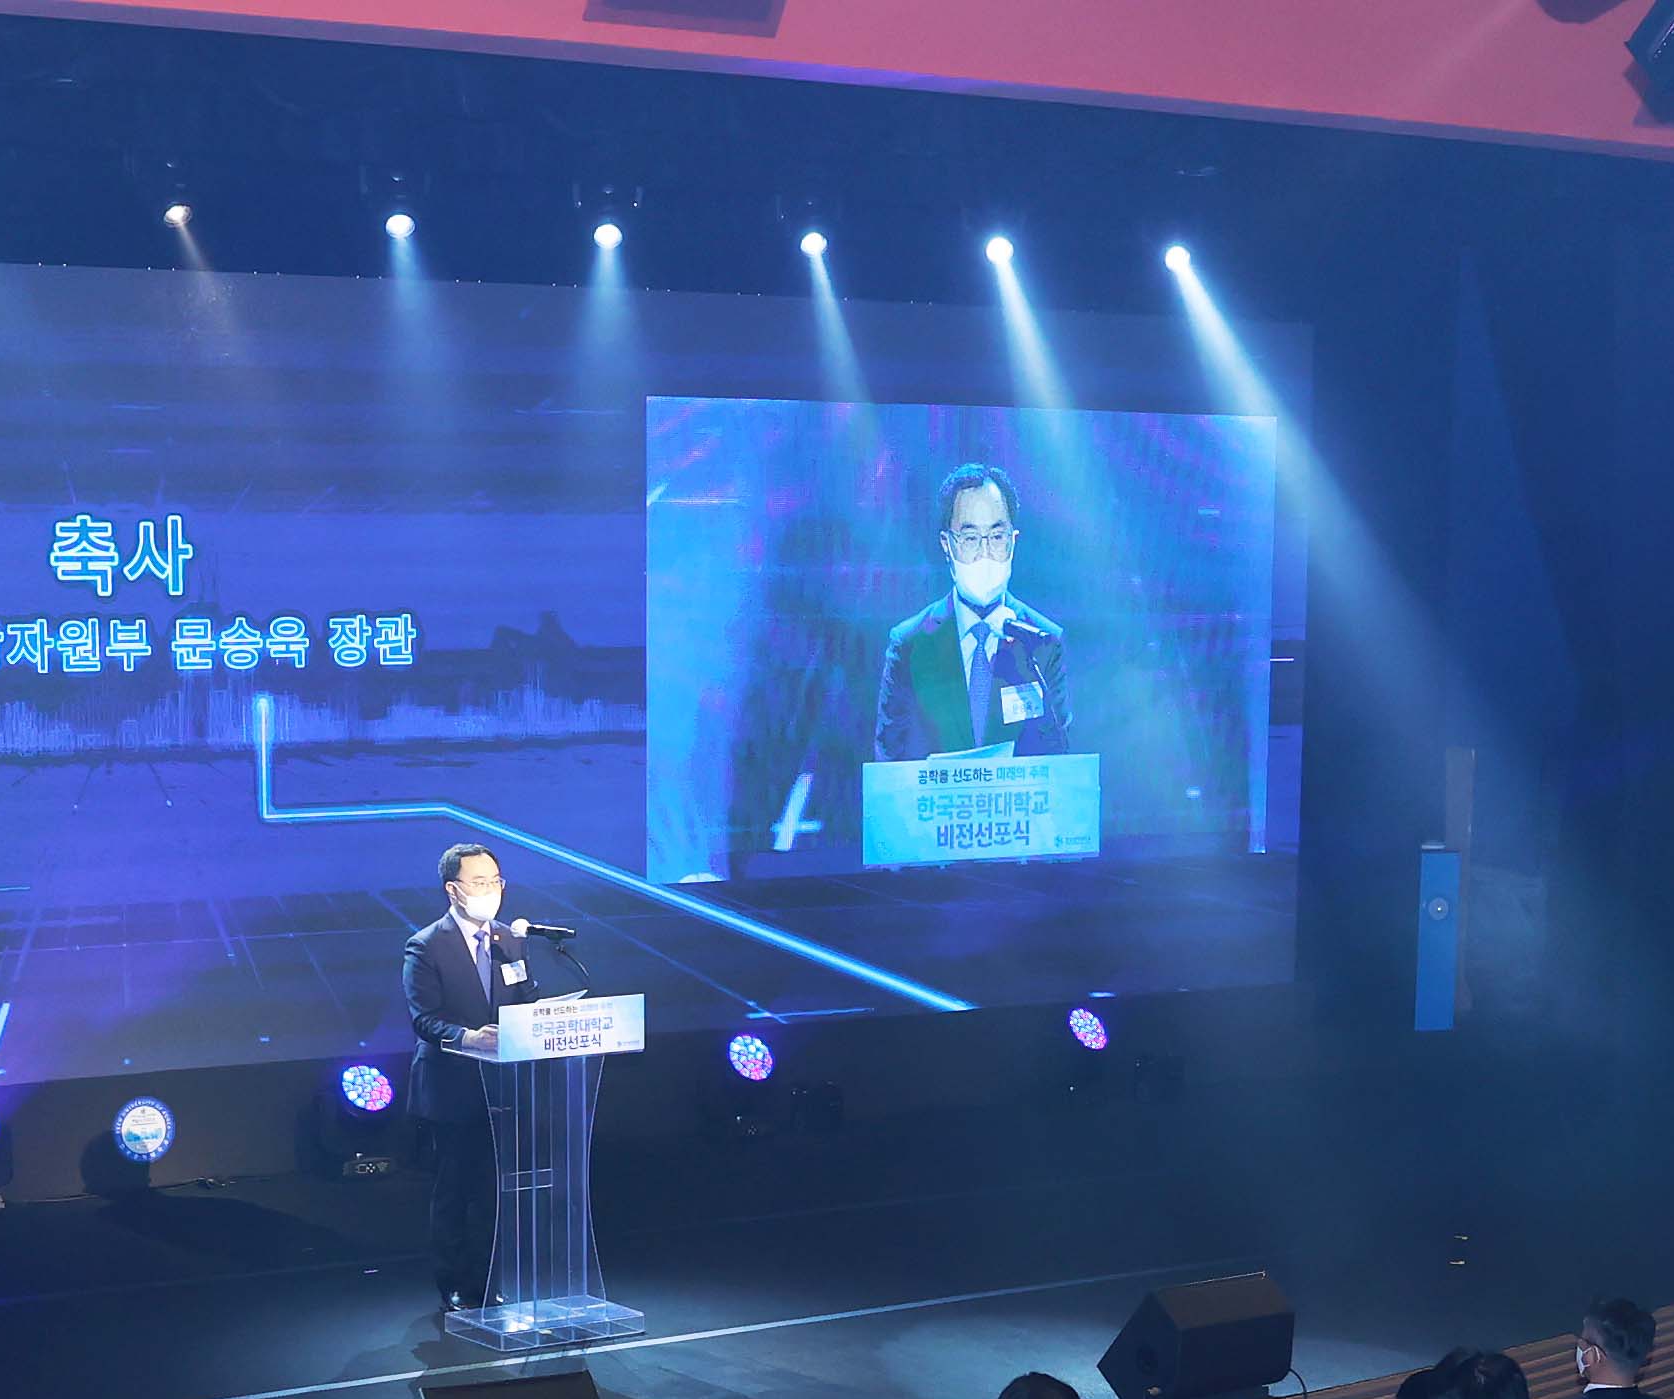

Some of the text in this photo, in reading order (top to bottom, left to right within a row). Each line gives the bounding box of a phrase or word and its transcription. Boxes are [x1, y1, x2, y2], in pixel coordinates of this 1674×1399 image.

[50, 514, 194, 598] 축사
[172, 617, 310, 671] 문승욱
[326, 613, 418, 668] 장관
[917, 768, 949, 785] 공학을
[952, 766, 994, 783] 선도하는
[917, 790, 1050, 822] 한국공학대학교
[936, 820, 1031, 849] 비전선포식
[532, 1016, 614, 1037] 한국공학대학교
[543, 1033, 602, 1052] 비전선포식
